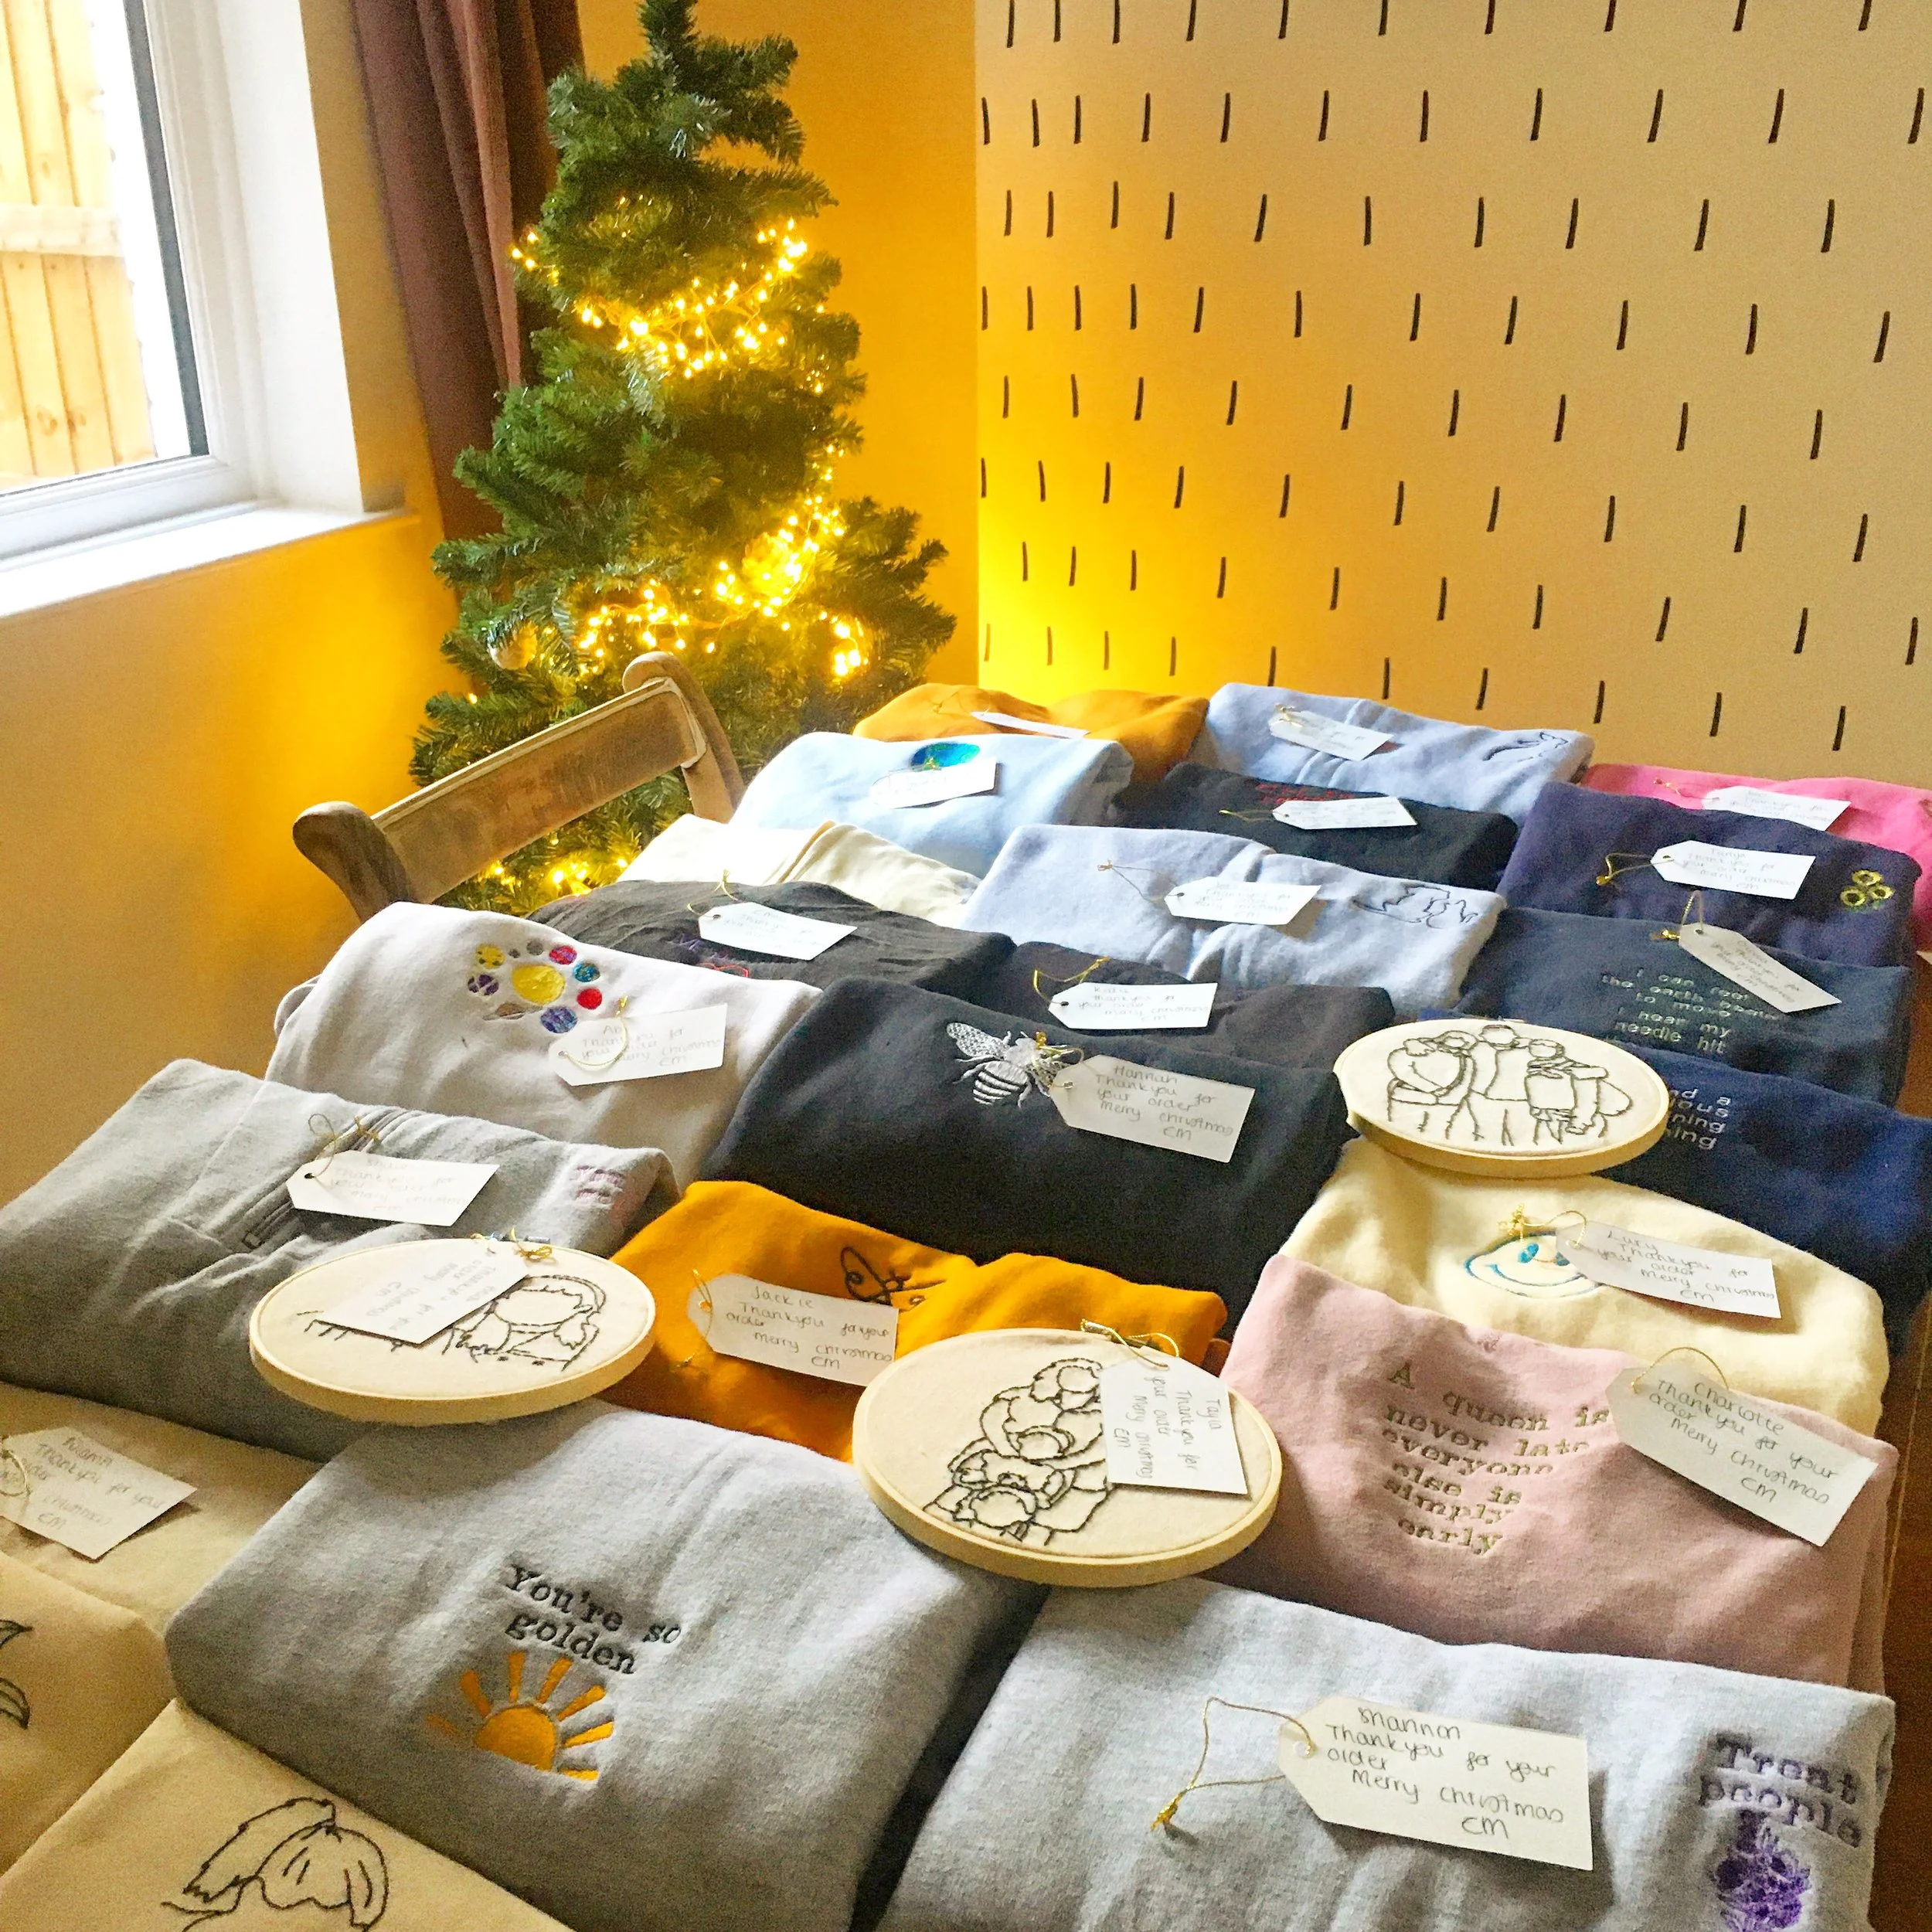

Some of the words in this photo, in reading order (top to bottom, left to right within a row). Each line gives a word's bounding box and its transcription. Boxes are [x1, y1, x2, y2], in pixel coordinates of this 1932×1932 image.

[1614, 1021, 1682, 1043] needle
[1698, 1036, 1728, 1055] hit
[1699, 1022, 1733, 1039] my
[1113, 1064, 1178, 1084] Hannah
[1147, 1096, 1196, 1112] order
[1194, 1092, 1218, 1107] for
[1716, 1096, 1732, 1107] a
[753, 1285, 815, 1309] Jackie
[1389, 1361, 1415, 1389] A
[1442, 1391, 1549, 1431] queen
[1648, 1393, 1696, 1421] order
[1693, 1381, 1785, 1437] Charlotte
[1386, 1403, 1489, 1452] never
[1512, 1437, 1590, 1458] late
[1382, 1429, 1553, 1477] everyone
[1789, 1451, 1841, 1480] your
[1393, 1463, 1463, 1497] else
[1487, 1485, 1523, 1505] is
[1383, 1478, 1515, 1526] simply
[1397, 1519, 1504, 1556] early
[505, 1563, 623, 1632] You're
[641, 1622, 682, 1645] so
[505, 1612, 635, 1675] golden
[1327, 1747, 1388, 1771] order
[1466, 1751, 1491, 1771] for
[1505, 1760, 1558, 1783] your
[1352, 1769, 1420, 1804] Merry
[1698, 1774, 1863, 1849] people
